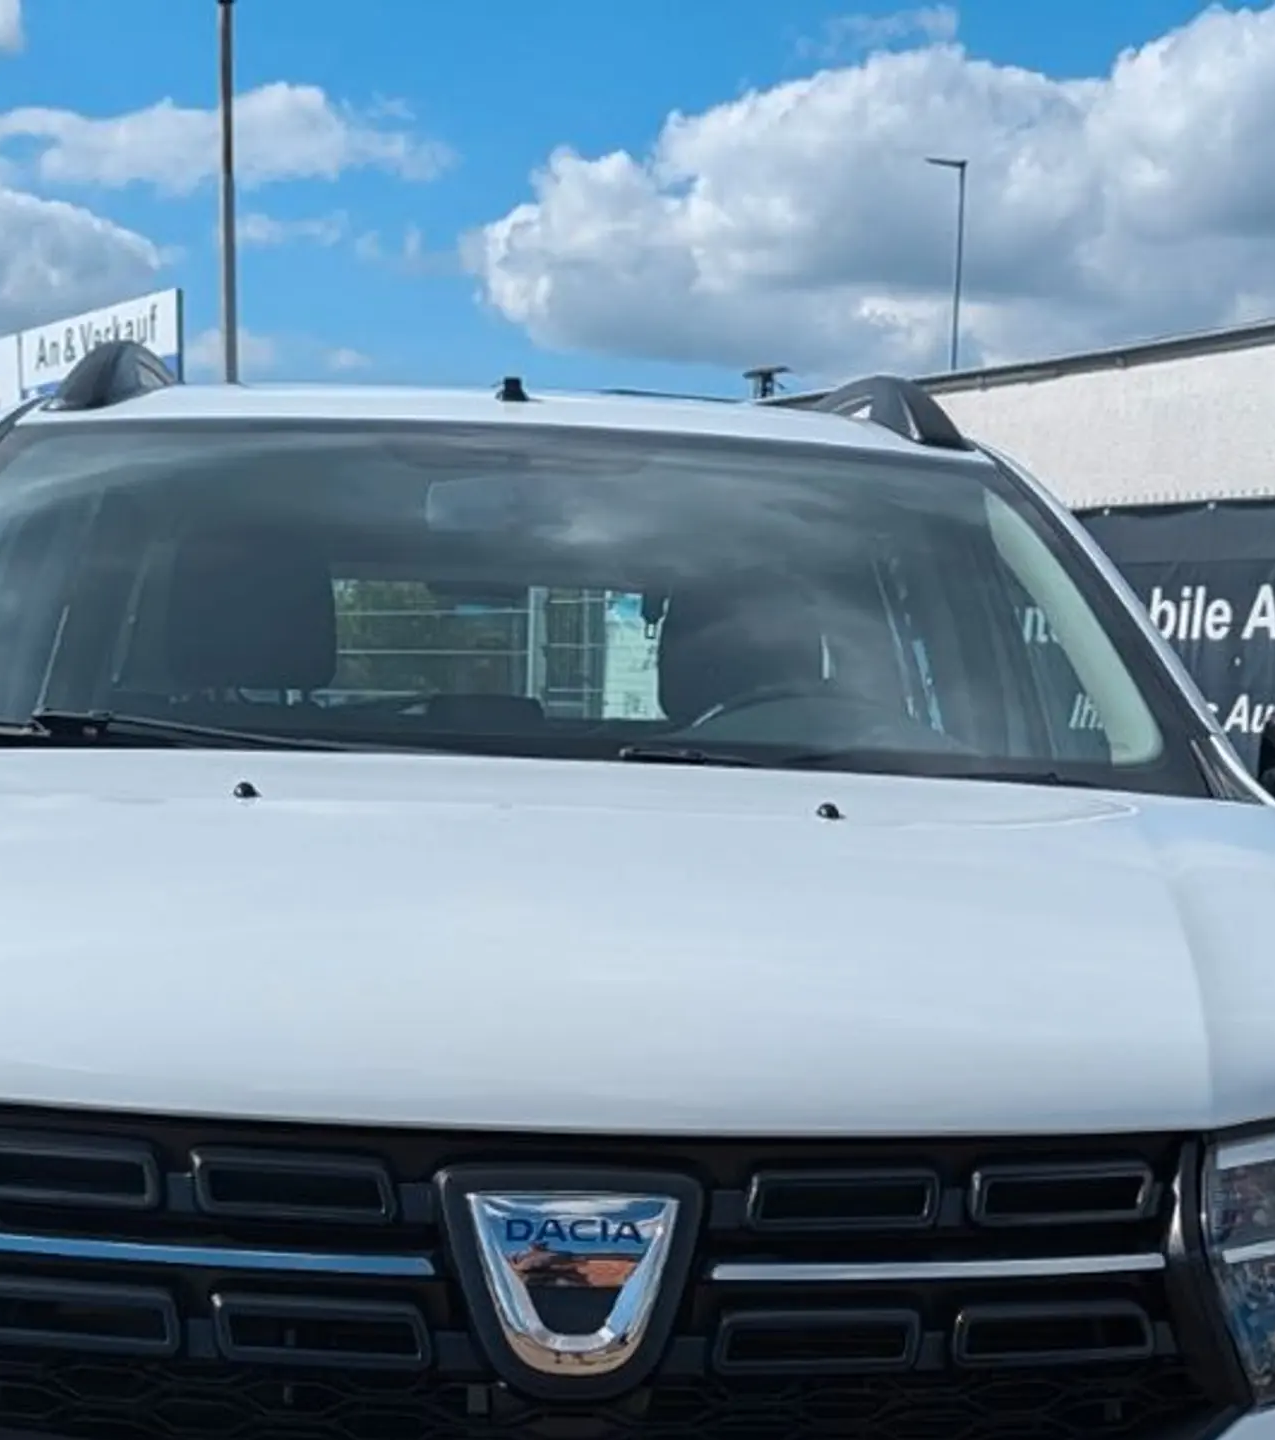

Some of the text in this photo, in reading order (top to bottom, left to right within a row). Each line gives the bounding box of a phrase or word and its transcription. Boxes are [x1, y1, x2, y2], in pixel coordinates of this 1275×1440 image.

[35, 336, 60, 370] An
[64, 326, 76, 363] &
[505, 1219, 644, 1245] DACIA
